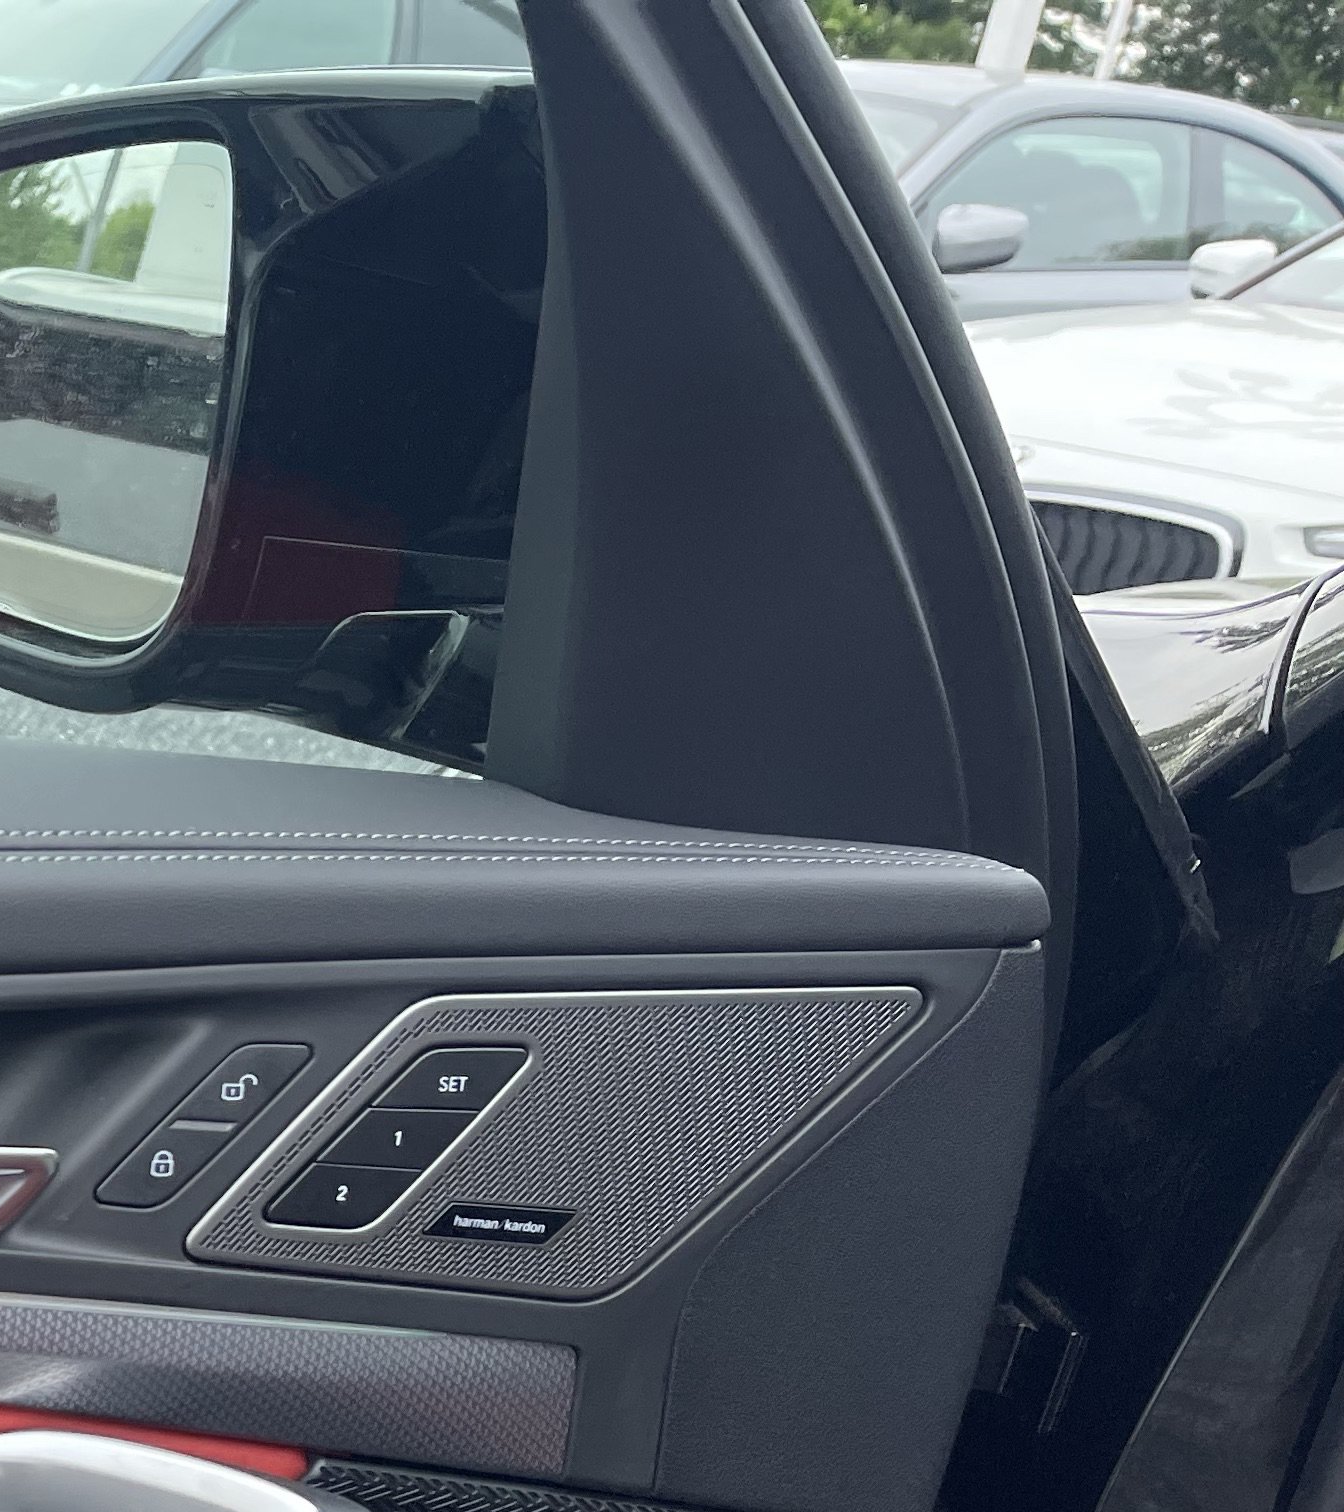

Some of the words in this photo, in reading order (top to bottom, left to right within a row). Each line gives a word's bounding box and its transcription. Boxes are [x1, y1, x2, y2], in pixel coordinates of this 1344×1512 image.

[438, 1076, 469, 1093] SET
[394, 1130, 403, 1147] 1
[335, 1185, 349, 1202] 2
